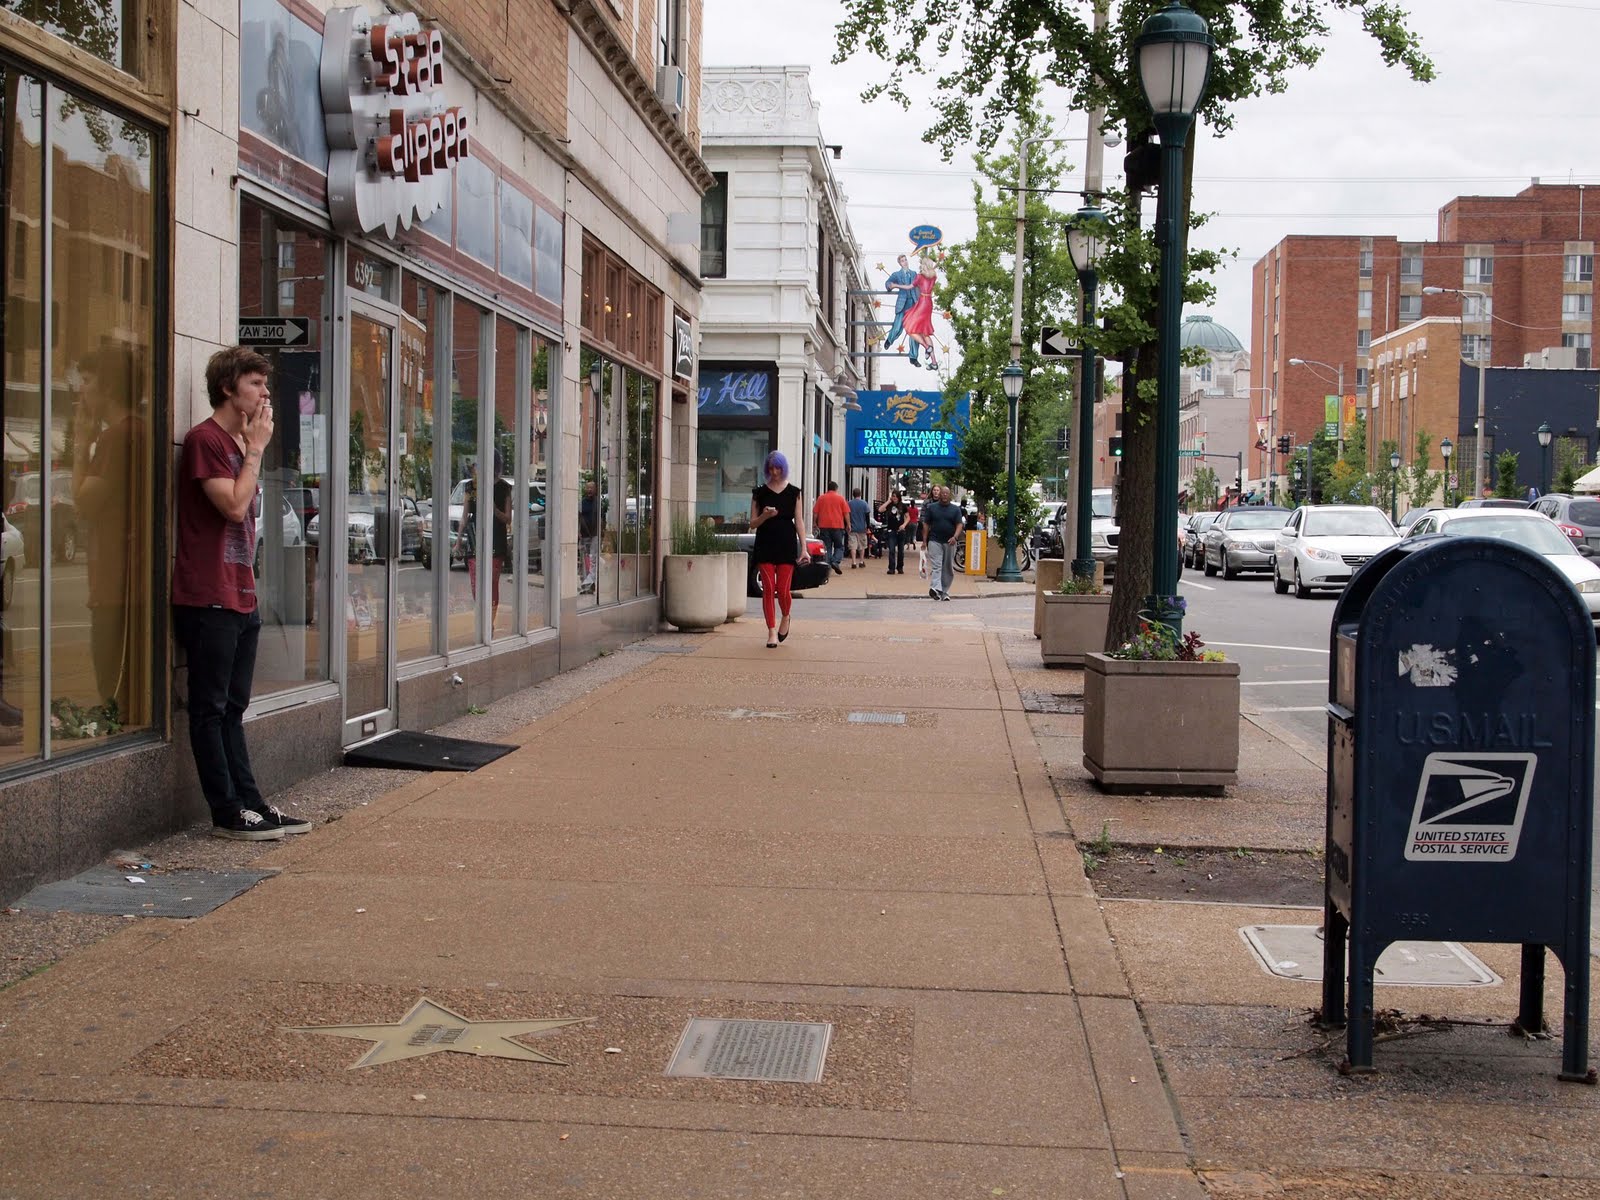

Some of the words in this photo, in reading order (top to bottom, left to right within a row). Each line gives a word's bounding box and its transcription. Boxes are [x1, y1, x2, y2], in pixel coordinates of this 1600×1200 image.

[354, 259, 374, 288] 6392
[716, 372, 768, 411] Hill
[864, 429, 888, 439] DAR
[888, 430, 942, 440] WILLIAMS
[944, 432, 953, 440] &
[867, 439, 897, 448] SARA
[898, 439, 948, 448] WATKINS
[863, 447, 915, 456] SATURDAY,
[917, 447, 940, 456] JULY
[1460, 711, 1553, 747] MAIL
[1415, 831, 1461, 841] UNITED
[1463, 831, 1506, 842] STATES
[1412, 844, 1457, 854] POSTAL
[1459, 844, 1509, 855] SERVICE
